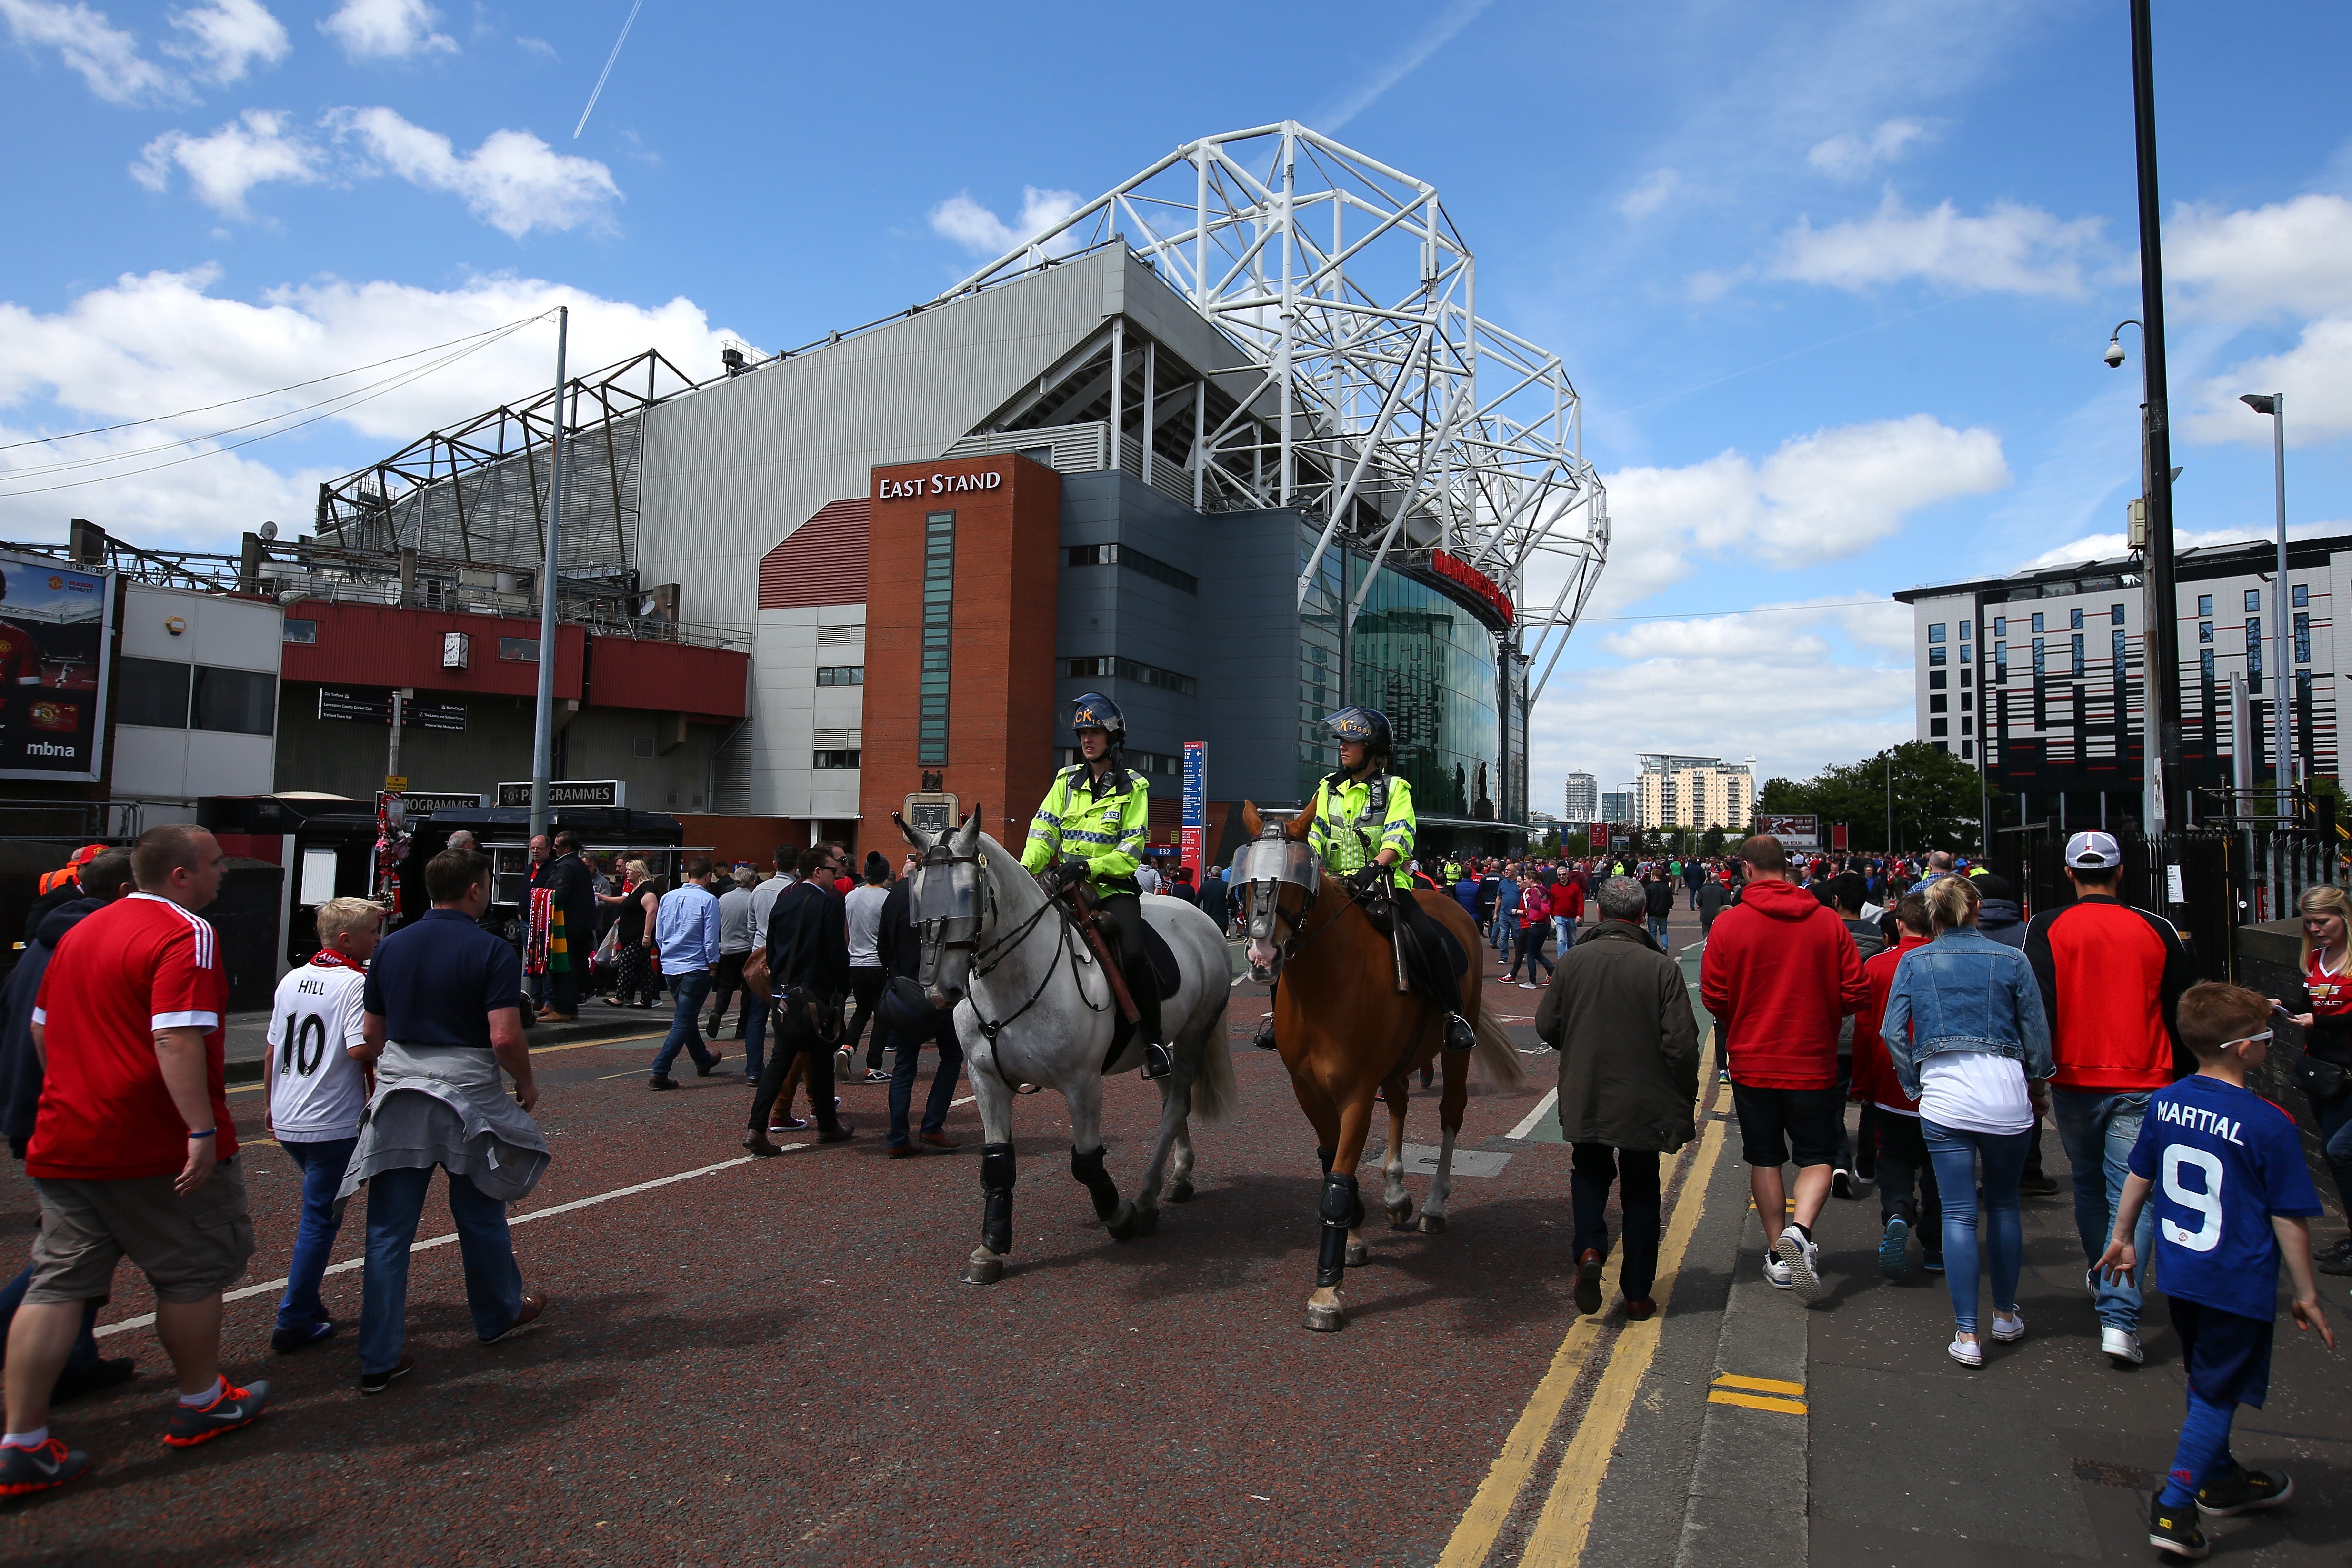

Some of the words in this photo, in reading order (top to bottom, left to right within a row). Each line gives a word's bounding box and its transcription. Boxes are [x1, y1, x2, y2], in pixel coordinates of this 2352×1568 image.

[68, 580, 93, 589] SEASON
[68, 585, 93, 593] 2016/17
[27, 741, 75, 757] mbna
[521, 788, 610, 801] PRGRAMMES
[404, 799, 474, 811] ROGRAMMES
[297, 979, 325, 995] HILL
[280, 1010, 327, 1078] 10
[2157, 1101, 2244, 1147] MARTIAL
[2161, 1143, 2224, 1252] 9
